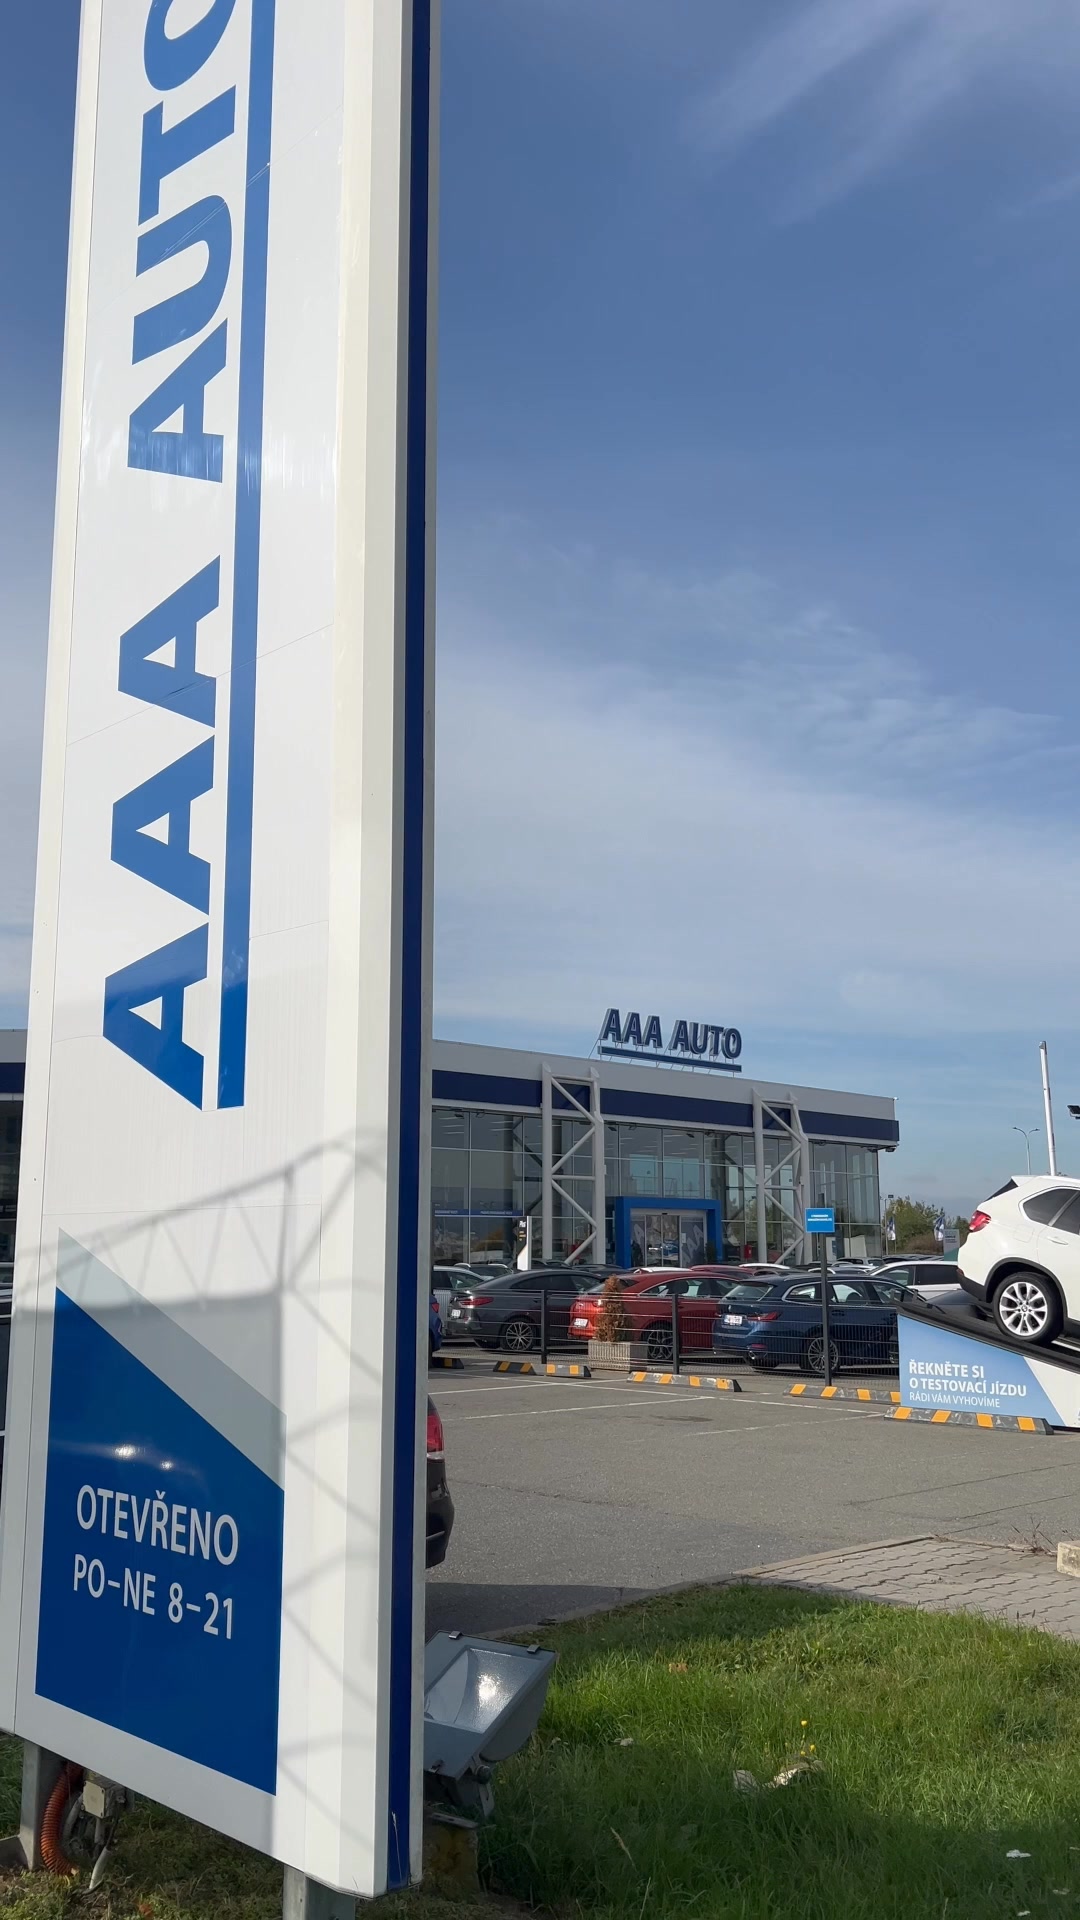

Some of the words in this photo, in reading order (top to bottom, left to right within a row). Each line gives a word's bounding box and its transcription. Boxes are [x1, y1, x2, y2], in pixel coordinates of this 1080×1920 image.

[103, 555, 220, 1110] AAA
[600, 1008, 663, 1048] AAA
[668, 1020, 742, 1059] AUTO
[909, 1359, 969, 1378] ŘEKNĚTE
[972, 1365, 985, 1379] SI
[909, 1377, 918, 1389] O
[920, 1377, 987, 1394] TESTOVACÍ
[989, 1380, 1027, 1397] JÍZDU
[909, 1391, 930, 1402] RÁDI
[931, 1393, 950, 1403] VÁM
[952, 1395, 1000, 1408] VYHOVÍME
[76, 1484, 239, 1566] OTEVŘENO
[73, 1553, 156, 1616] PO-NE
[168, 1582, 233, 1640] 8-21
